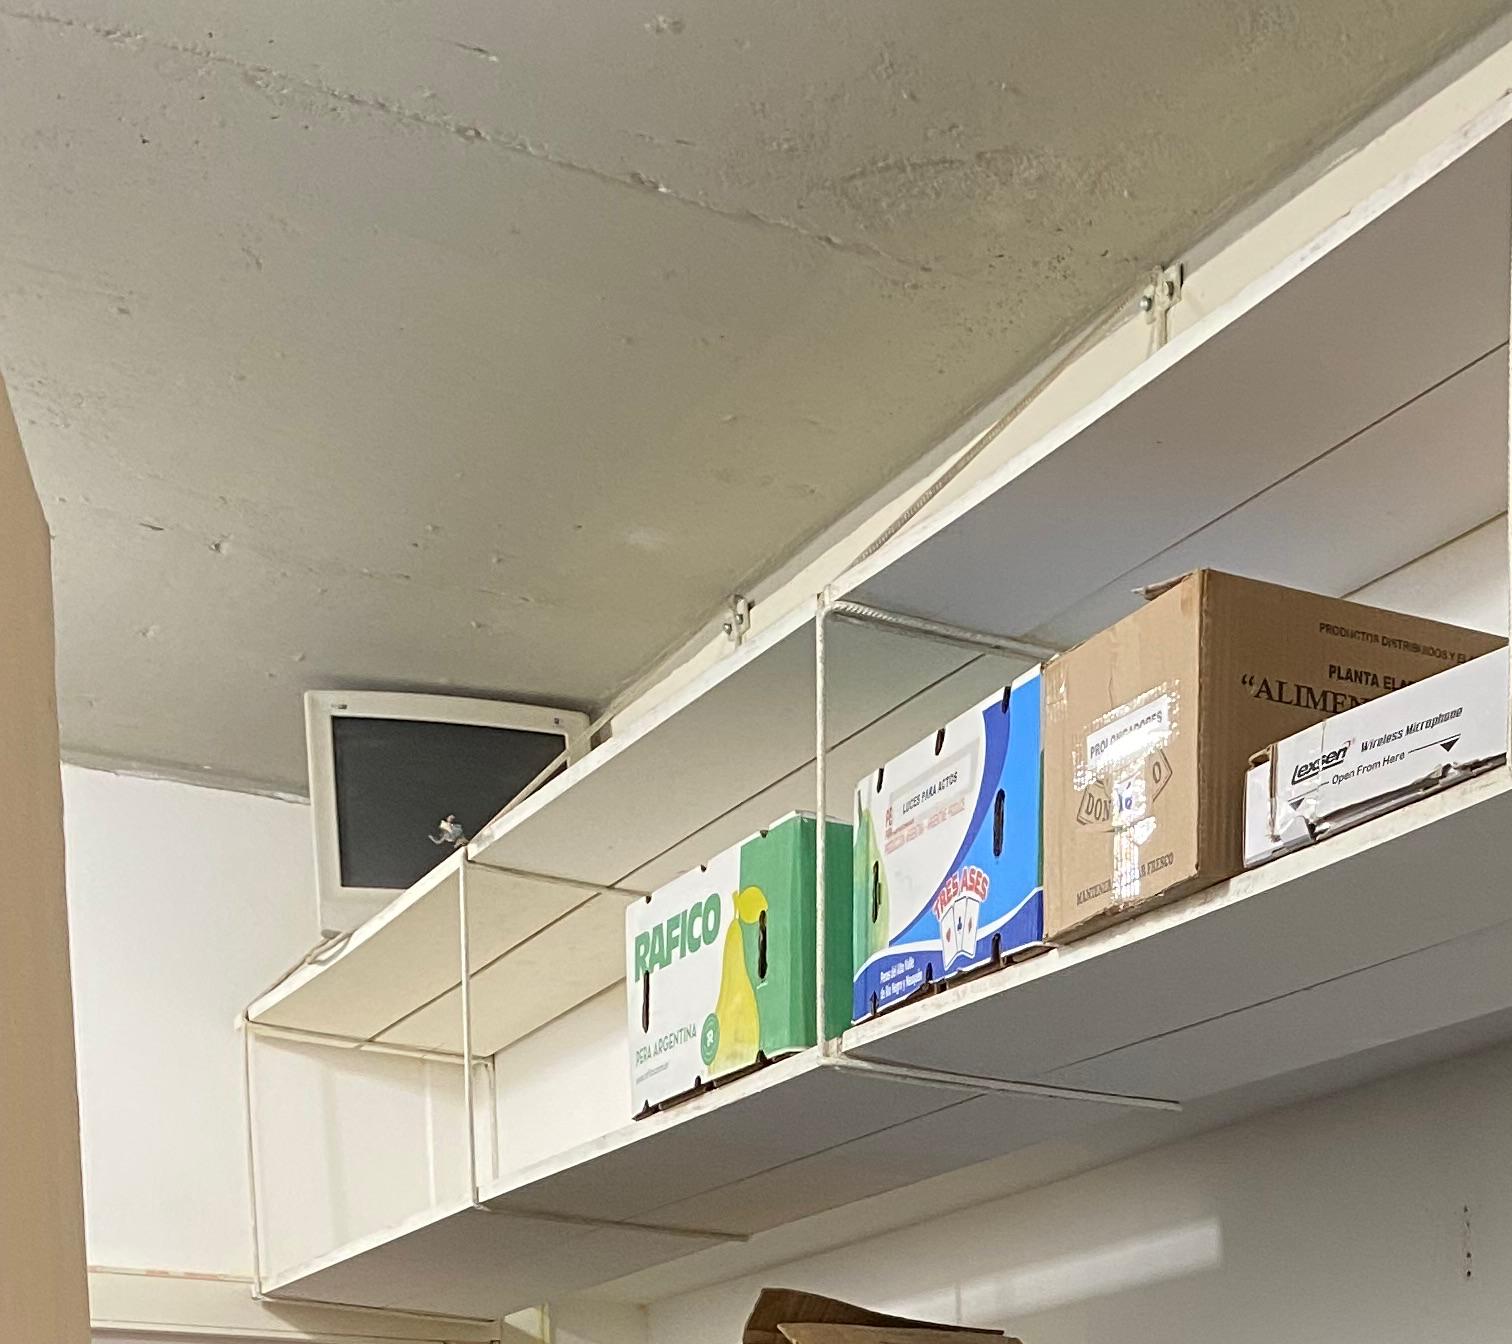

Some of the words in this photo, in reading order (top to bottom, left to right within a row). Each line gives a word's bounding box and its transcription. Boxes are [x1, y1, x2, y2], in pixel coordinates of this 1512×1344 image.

[1329, 664, 1379, 688] PLANTA
[1361, 729, 1404, 752] Wireless
[1405, 706, 1463, 737] Microphone
[1331, 769, 1355, 785] Open
[1356, 761, 1380, 776] From
[1382, 752, 1405, 768] Here
[902, 793, 920, 815] LUCES
[921, 784, 936, 804] PARA
[938, 771, 958, 792] ACTOS
[933, 873, 960, 920] TRES
[960, 867, 989, 901] ASES
[634, 893, 721, 983] RAFICO
[635, 1046, 652, 1067] PERA
[653, 1023, 697, 1060] ARGENTINA
